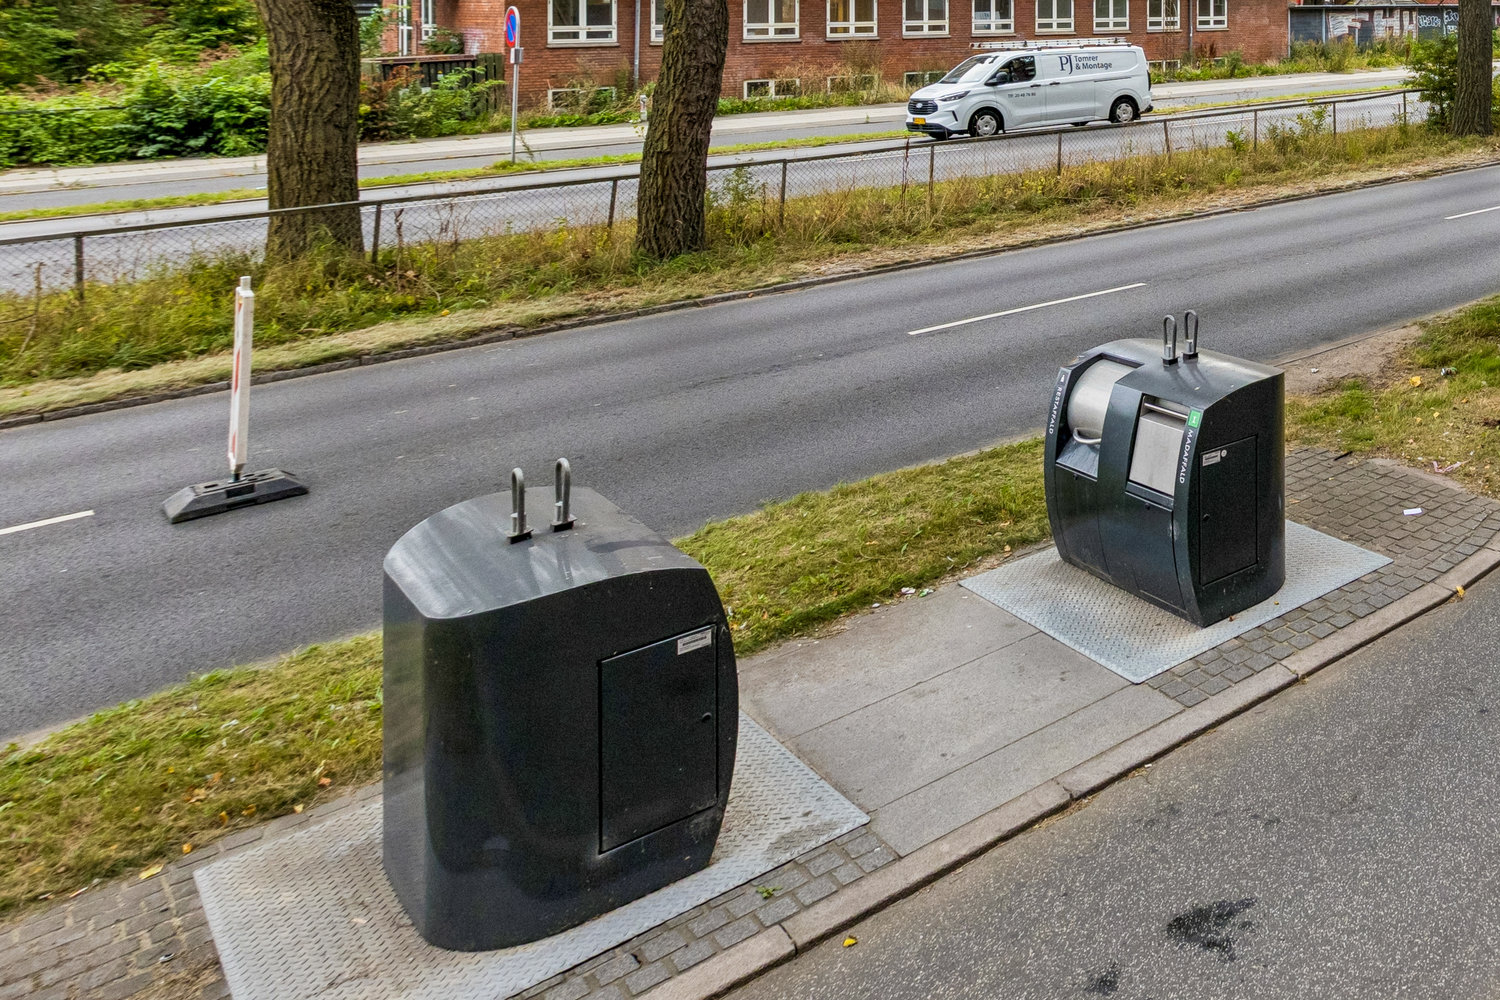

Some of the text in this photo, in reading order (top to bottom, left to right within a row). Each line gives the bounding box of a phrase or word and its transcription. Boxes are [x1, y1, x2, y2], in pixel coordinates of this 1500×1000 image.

[1058, 55, 1073, 75] PJ
[1082, 62, 1112, 70] Montage
[1048, 386, 1063, 435] RESTAFFALD
[1179, 428, 1194, 484] MADAFFALD
